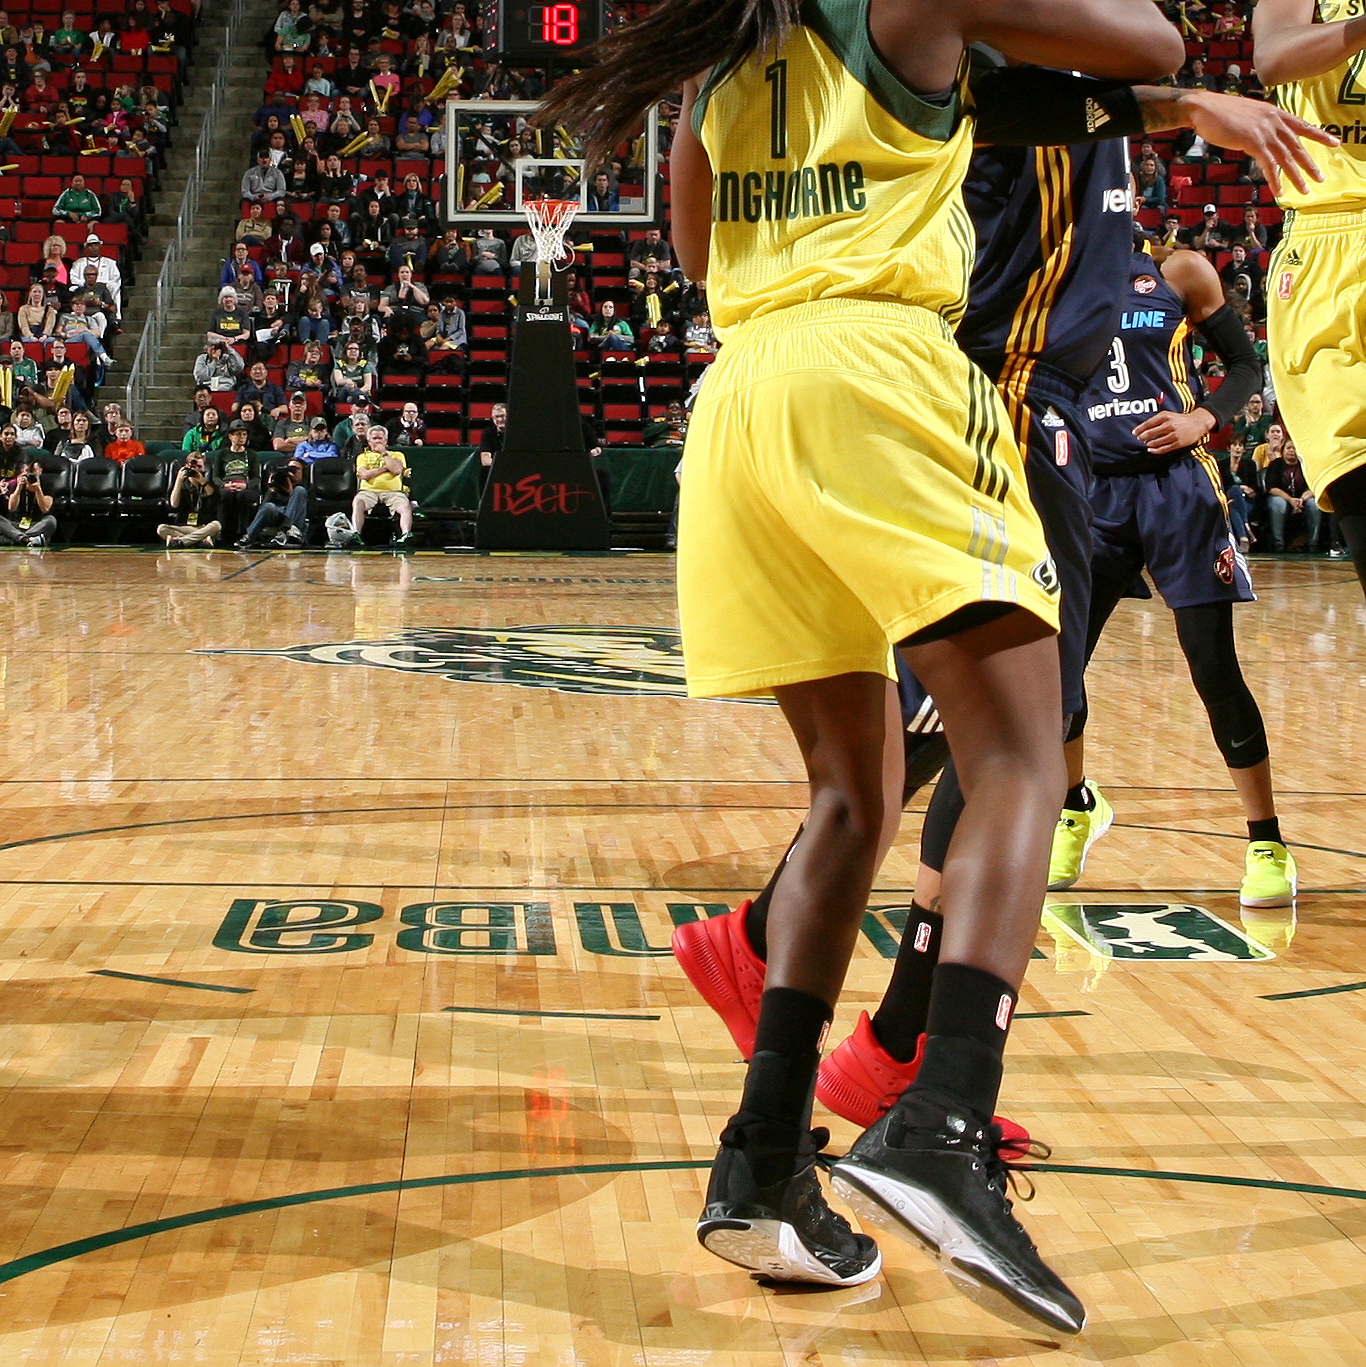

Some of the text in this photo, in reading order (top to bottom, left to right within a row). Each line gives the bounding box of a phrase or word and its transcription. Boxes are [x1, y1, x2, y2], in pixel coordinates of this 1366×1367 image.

[542, 3, 579, 46] 18
[764, 58, 788, 160] 1
[525, 311, 564, 323] SPALDING
[1121, 311, 1166, 330] LINE
[1106, 336, 1131, 394] 3
[1087, 398, 1158, 422] verizon
[492, 473, 596, 517] BECU
